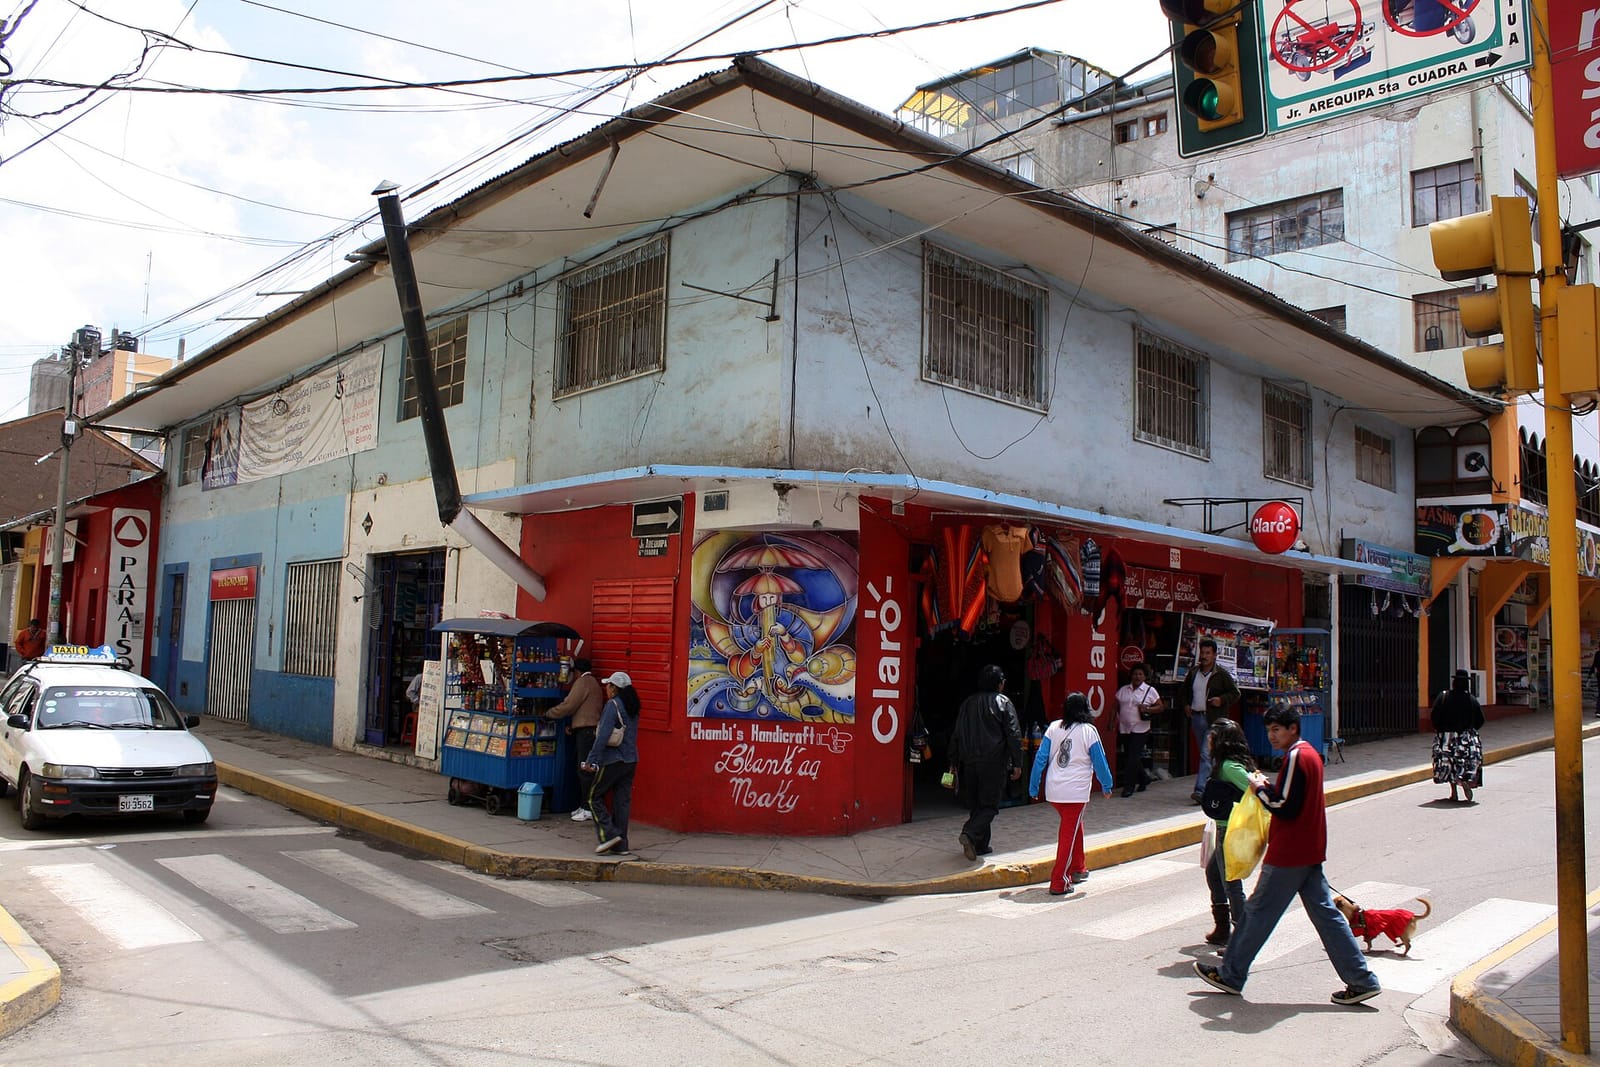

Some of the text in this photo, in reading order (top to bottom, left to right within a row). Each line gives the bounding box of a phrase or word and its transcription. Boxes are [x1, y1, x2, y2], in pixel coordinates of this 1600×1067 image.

[1286, 62, 1468, 120] Jr. AREQUIPA 5ta CUADRA
[1252, 516, 1289, 533] Claro
[1147, 577, 1166, 590] Claro
[1176, 581, 1194, 592] Claro
[1145, 588, 1171, 600] RECARGA
[1174, 591, 1200, 602] RECARGA
[54, 646, 75, 654] TAXI
[868, 588, 901, 744] Claro
[74, 690, 138, 698] TOYOTA
[690, 721, 815, 745] Chambi's Handicraft
